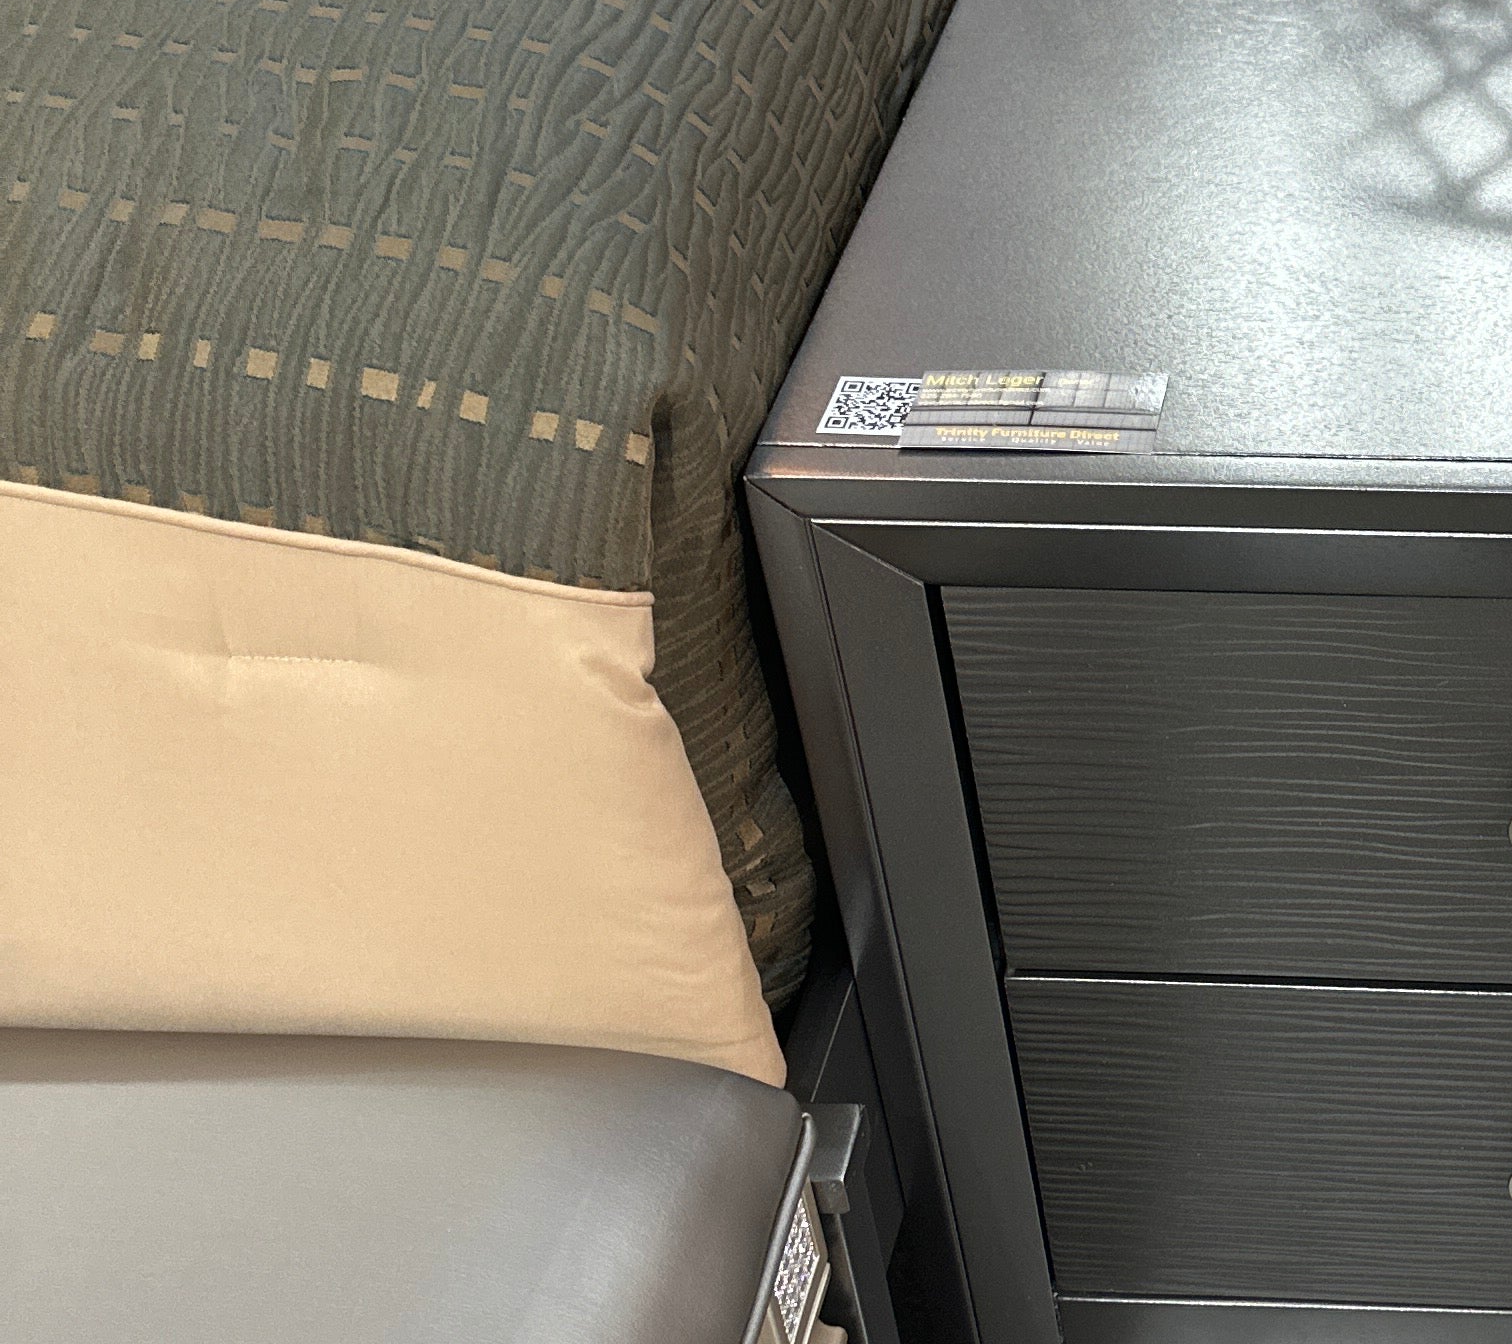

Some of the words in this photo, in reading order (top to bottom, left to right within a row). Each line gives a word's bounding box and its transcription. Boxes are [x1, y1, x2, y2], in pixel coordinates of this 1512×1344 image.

[926, 374, 979, 386] Mitch
[935, 427, 988, 438] Trinity
[992, 428, 1067, 439] Furniture
[1070, 430, 1120, 441] Direct
